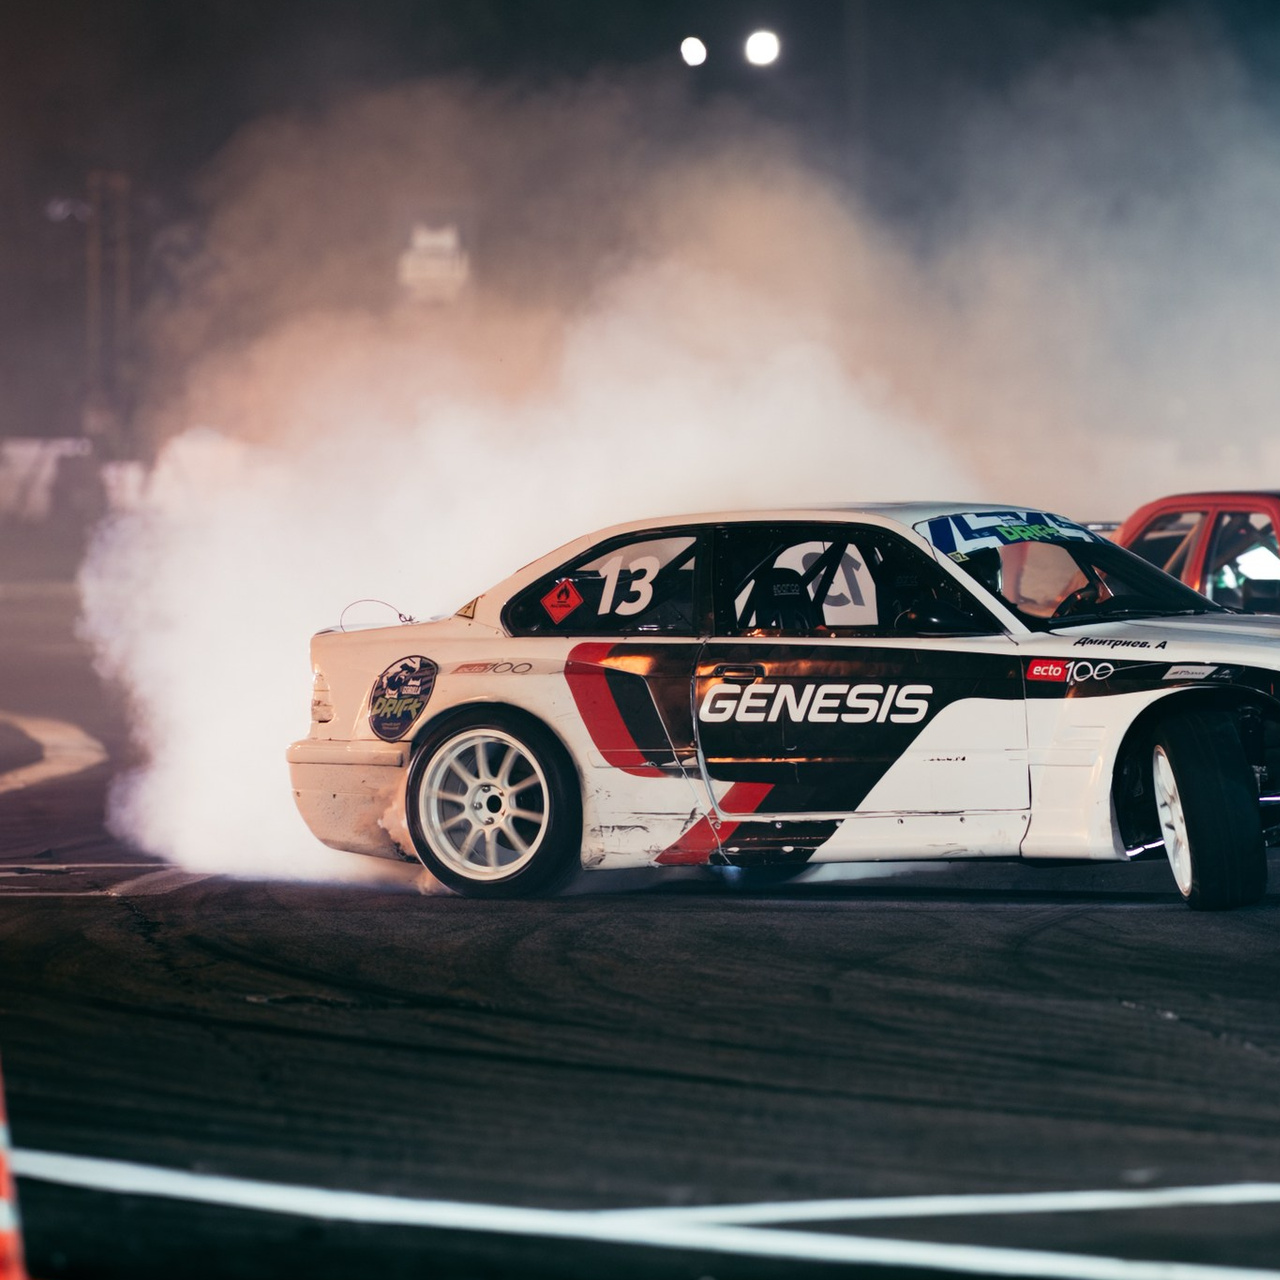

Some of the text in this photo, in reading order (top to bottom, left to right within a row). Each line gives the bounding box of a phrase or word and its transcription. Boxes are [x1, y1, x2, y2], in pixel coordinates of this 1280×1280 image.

[597, 555, 661, 616] 13
[1073, 636, 1151, 650] Дмитриев.
[698, 683, 934, 724] GENESIS
